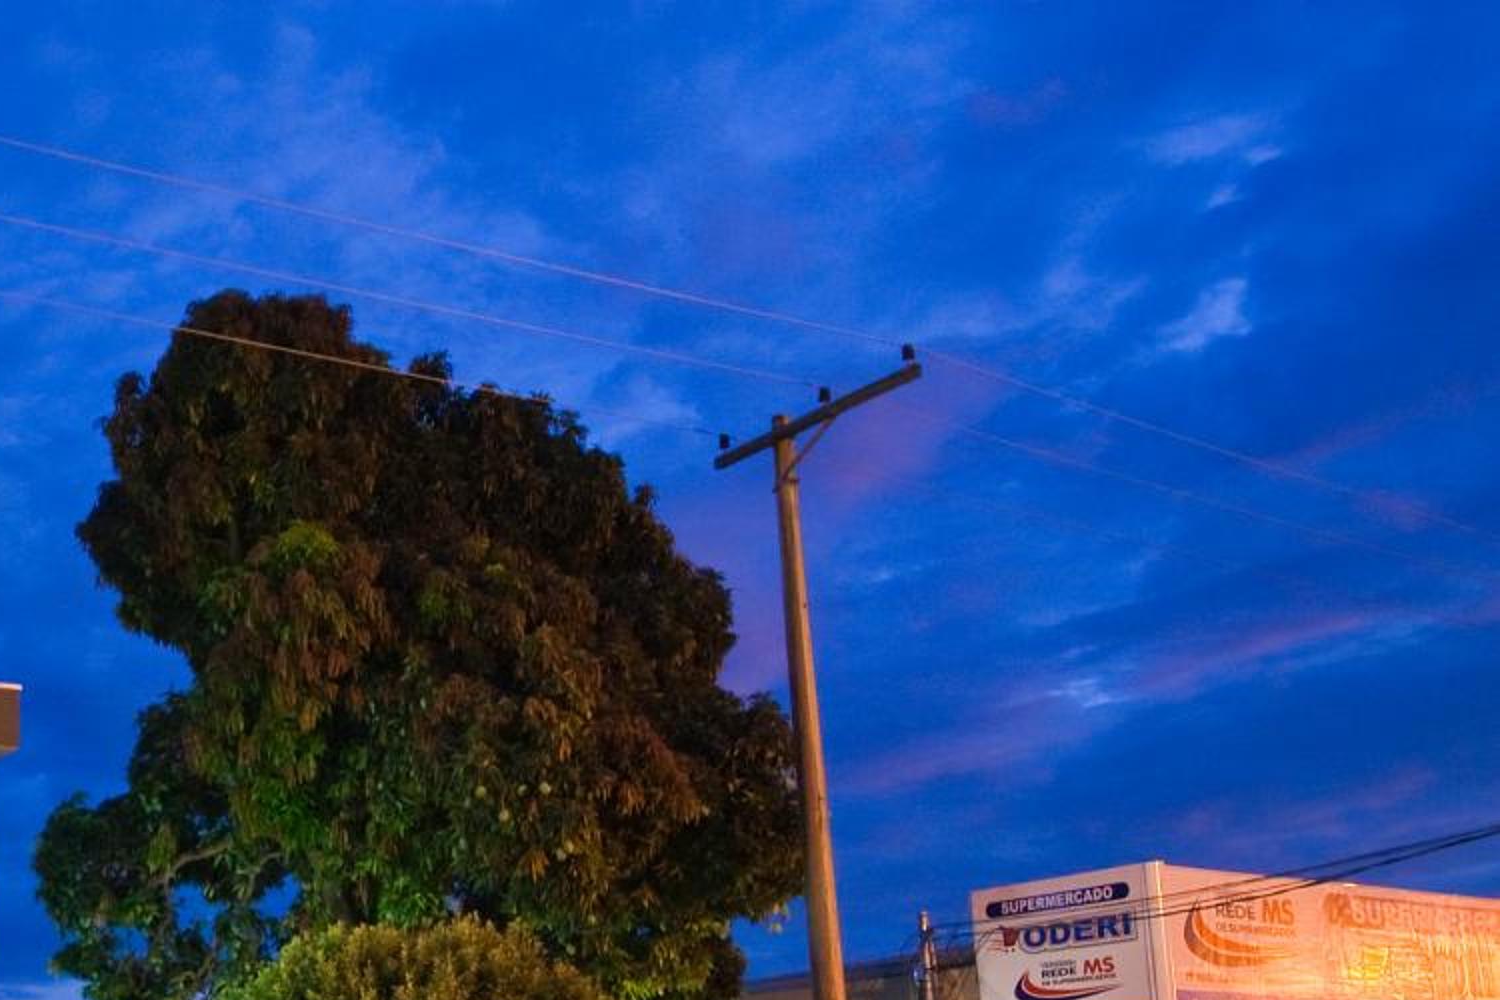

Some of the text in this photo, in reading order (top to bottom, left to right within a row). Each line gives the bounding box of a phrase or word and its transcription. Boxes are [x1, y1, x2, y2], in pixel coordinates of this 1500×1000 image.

[1001, 886, 1113, 915] SUPERMERCADO
[1215, 898, 1295, 926] REDE MS
[1041, 966, 1076, 979] REDE
[1083, 957, 1115, 975] MS
